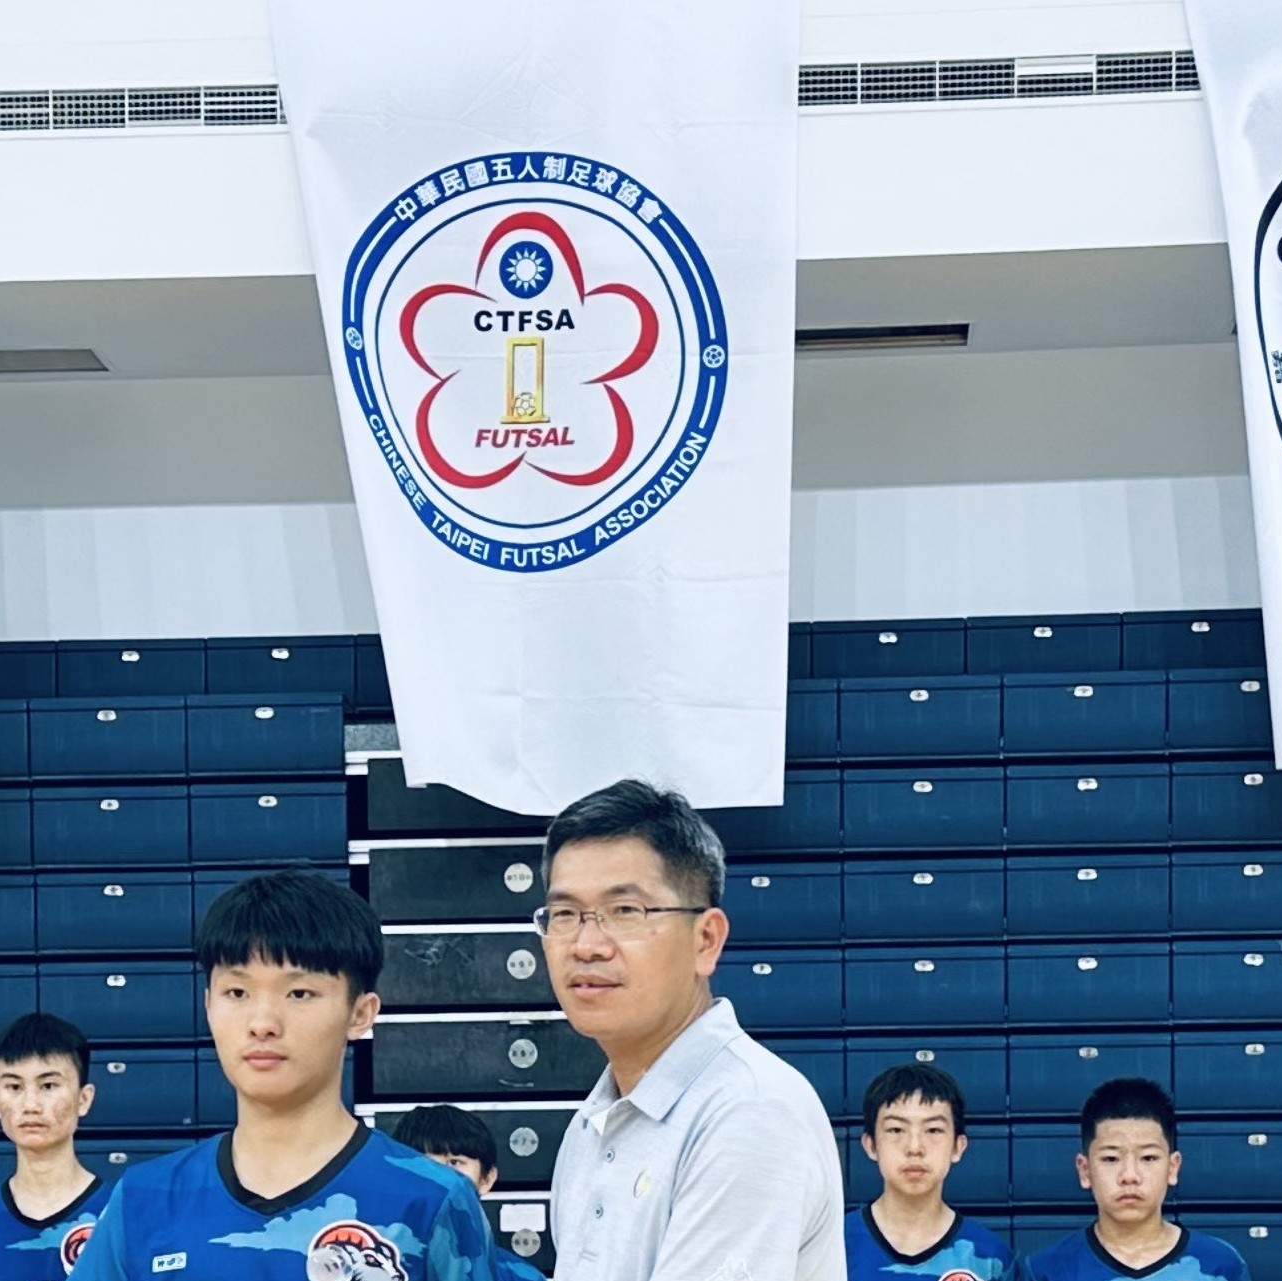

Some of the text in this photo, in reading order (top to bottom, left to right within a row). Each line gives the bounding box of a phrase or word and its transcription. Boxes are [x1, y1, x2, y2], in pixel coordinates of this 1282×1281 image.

[394, 155, 664, 223] 中華民國五人制足球協會
[474, 310, 575, 332] CTFSA
[475, 427, 575, 448] FUTSAL
[369, 415, 707, 567] CHINESE TAIPEI FUTSAL ASSOCIATION
